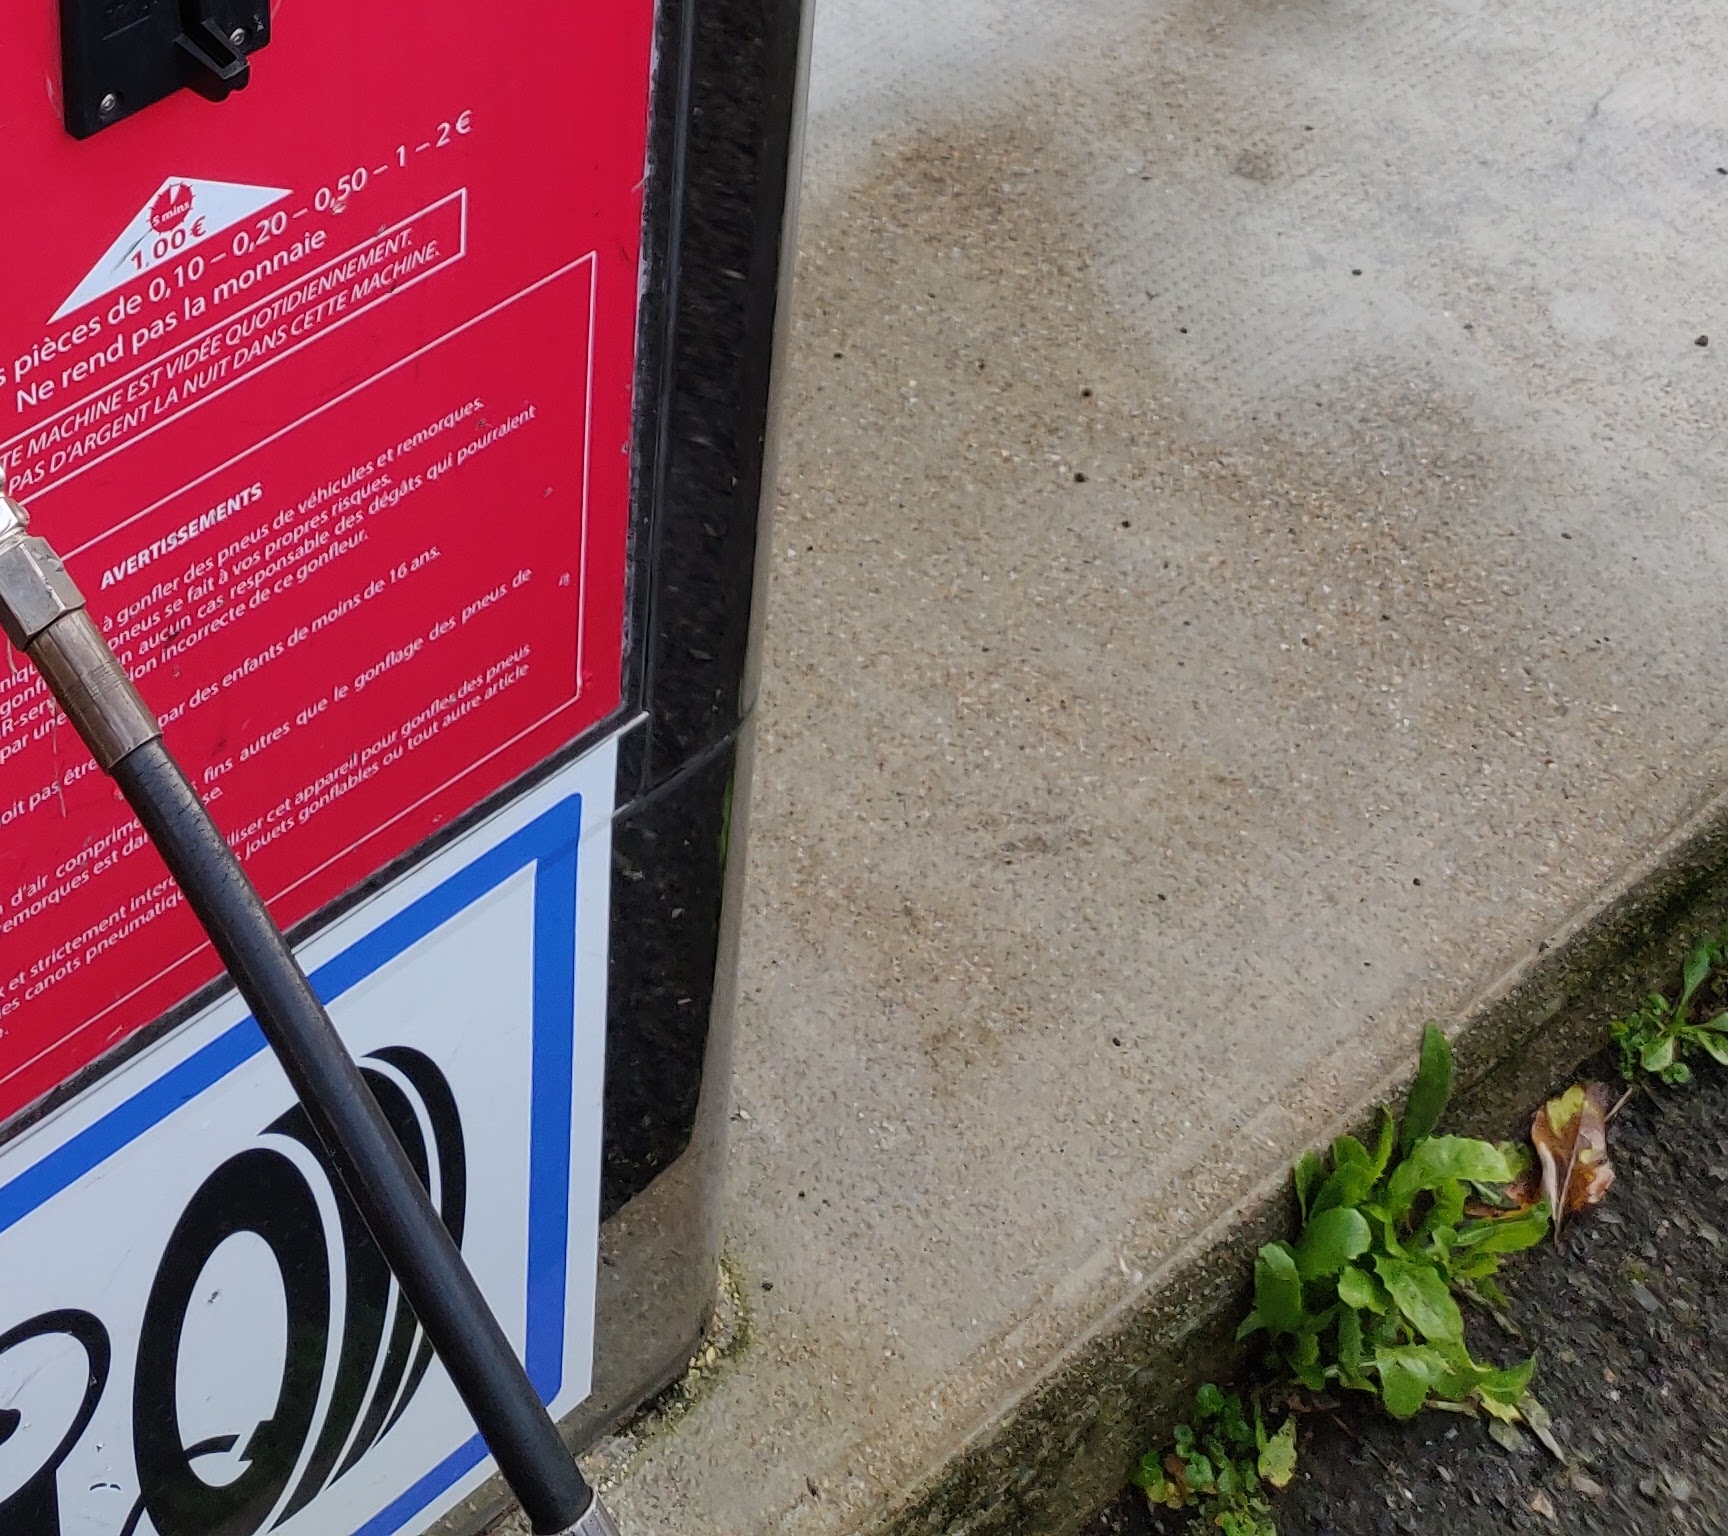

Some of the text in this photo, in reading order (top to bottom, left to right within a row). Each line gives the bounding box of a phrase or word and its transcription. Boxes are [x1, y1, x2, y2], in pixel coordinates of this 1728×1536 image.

[13, 315, 101, 383] pièces
[106, 294, 142, 324] de
[148, 255, 204, 302] 0,10
[232, 210, 287, 256] 0,20
[314, 166, 367, 211] 0,50
[394, 143, 406, 168] 1
[435, 121, 450, 148] 2
[455, 108, 472, 135] €
[189, 215, 207, 238] €
[16, 229, 326, 413] Ne rend pas la monnaie
[26, 227, 412, 458] MACHINE EST VIDÉE QUOTIDIENNEMENT.
[100, 481, 262, 590] AVERTISSEMENTS
[157, 545, 441, 731] par des enfants de moins de 16 ans.
[28, 780, 62, 811] pas
[63, 757, 98, 785] être
